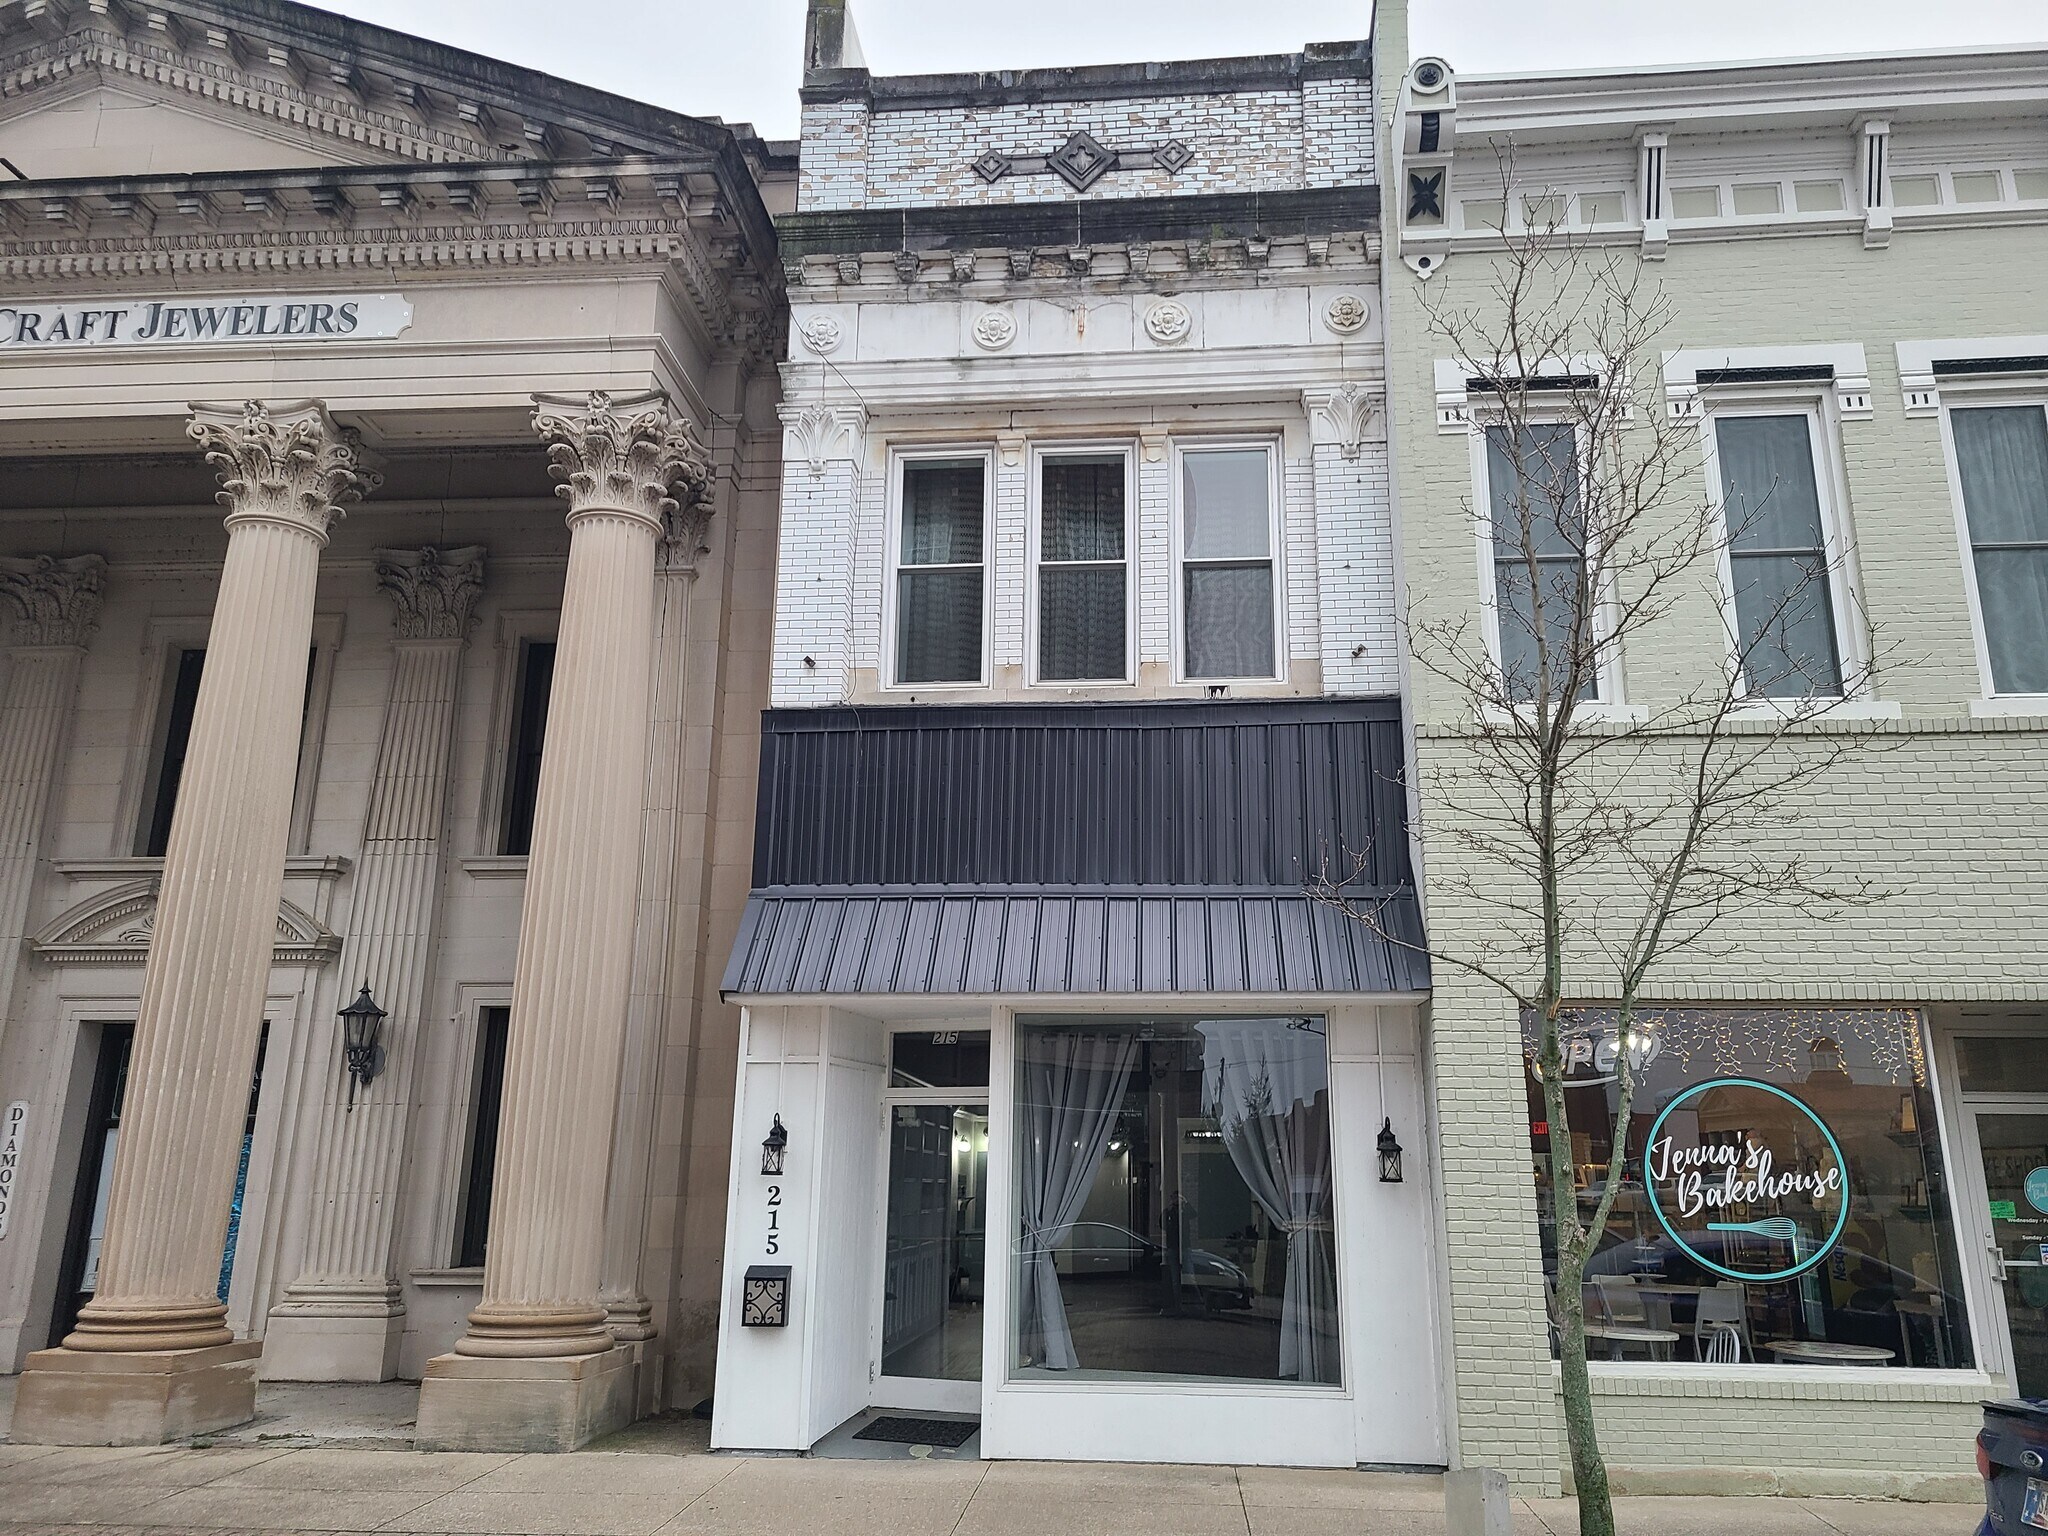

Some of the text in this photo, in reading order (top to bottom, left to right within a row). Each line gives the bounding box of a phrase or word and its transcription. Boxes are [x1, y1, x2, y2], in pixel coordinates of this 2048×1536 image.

[0, 301, 359, 343] CRAFT JEWELERS
[933, 1031, 958, 1044] 215
[1533, 1121, 1548, 1135] EXIT
[1649, 1131, 1764, 1181] Jenna's
[1678, 1149, 1843, 1218] Bakehouse
[765, 1185, 782, 1255] 215
[2007, 1217, 2039, 1225] Wednesday
[2021, 1234, 2042, 1242] Sunday
